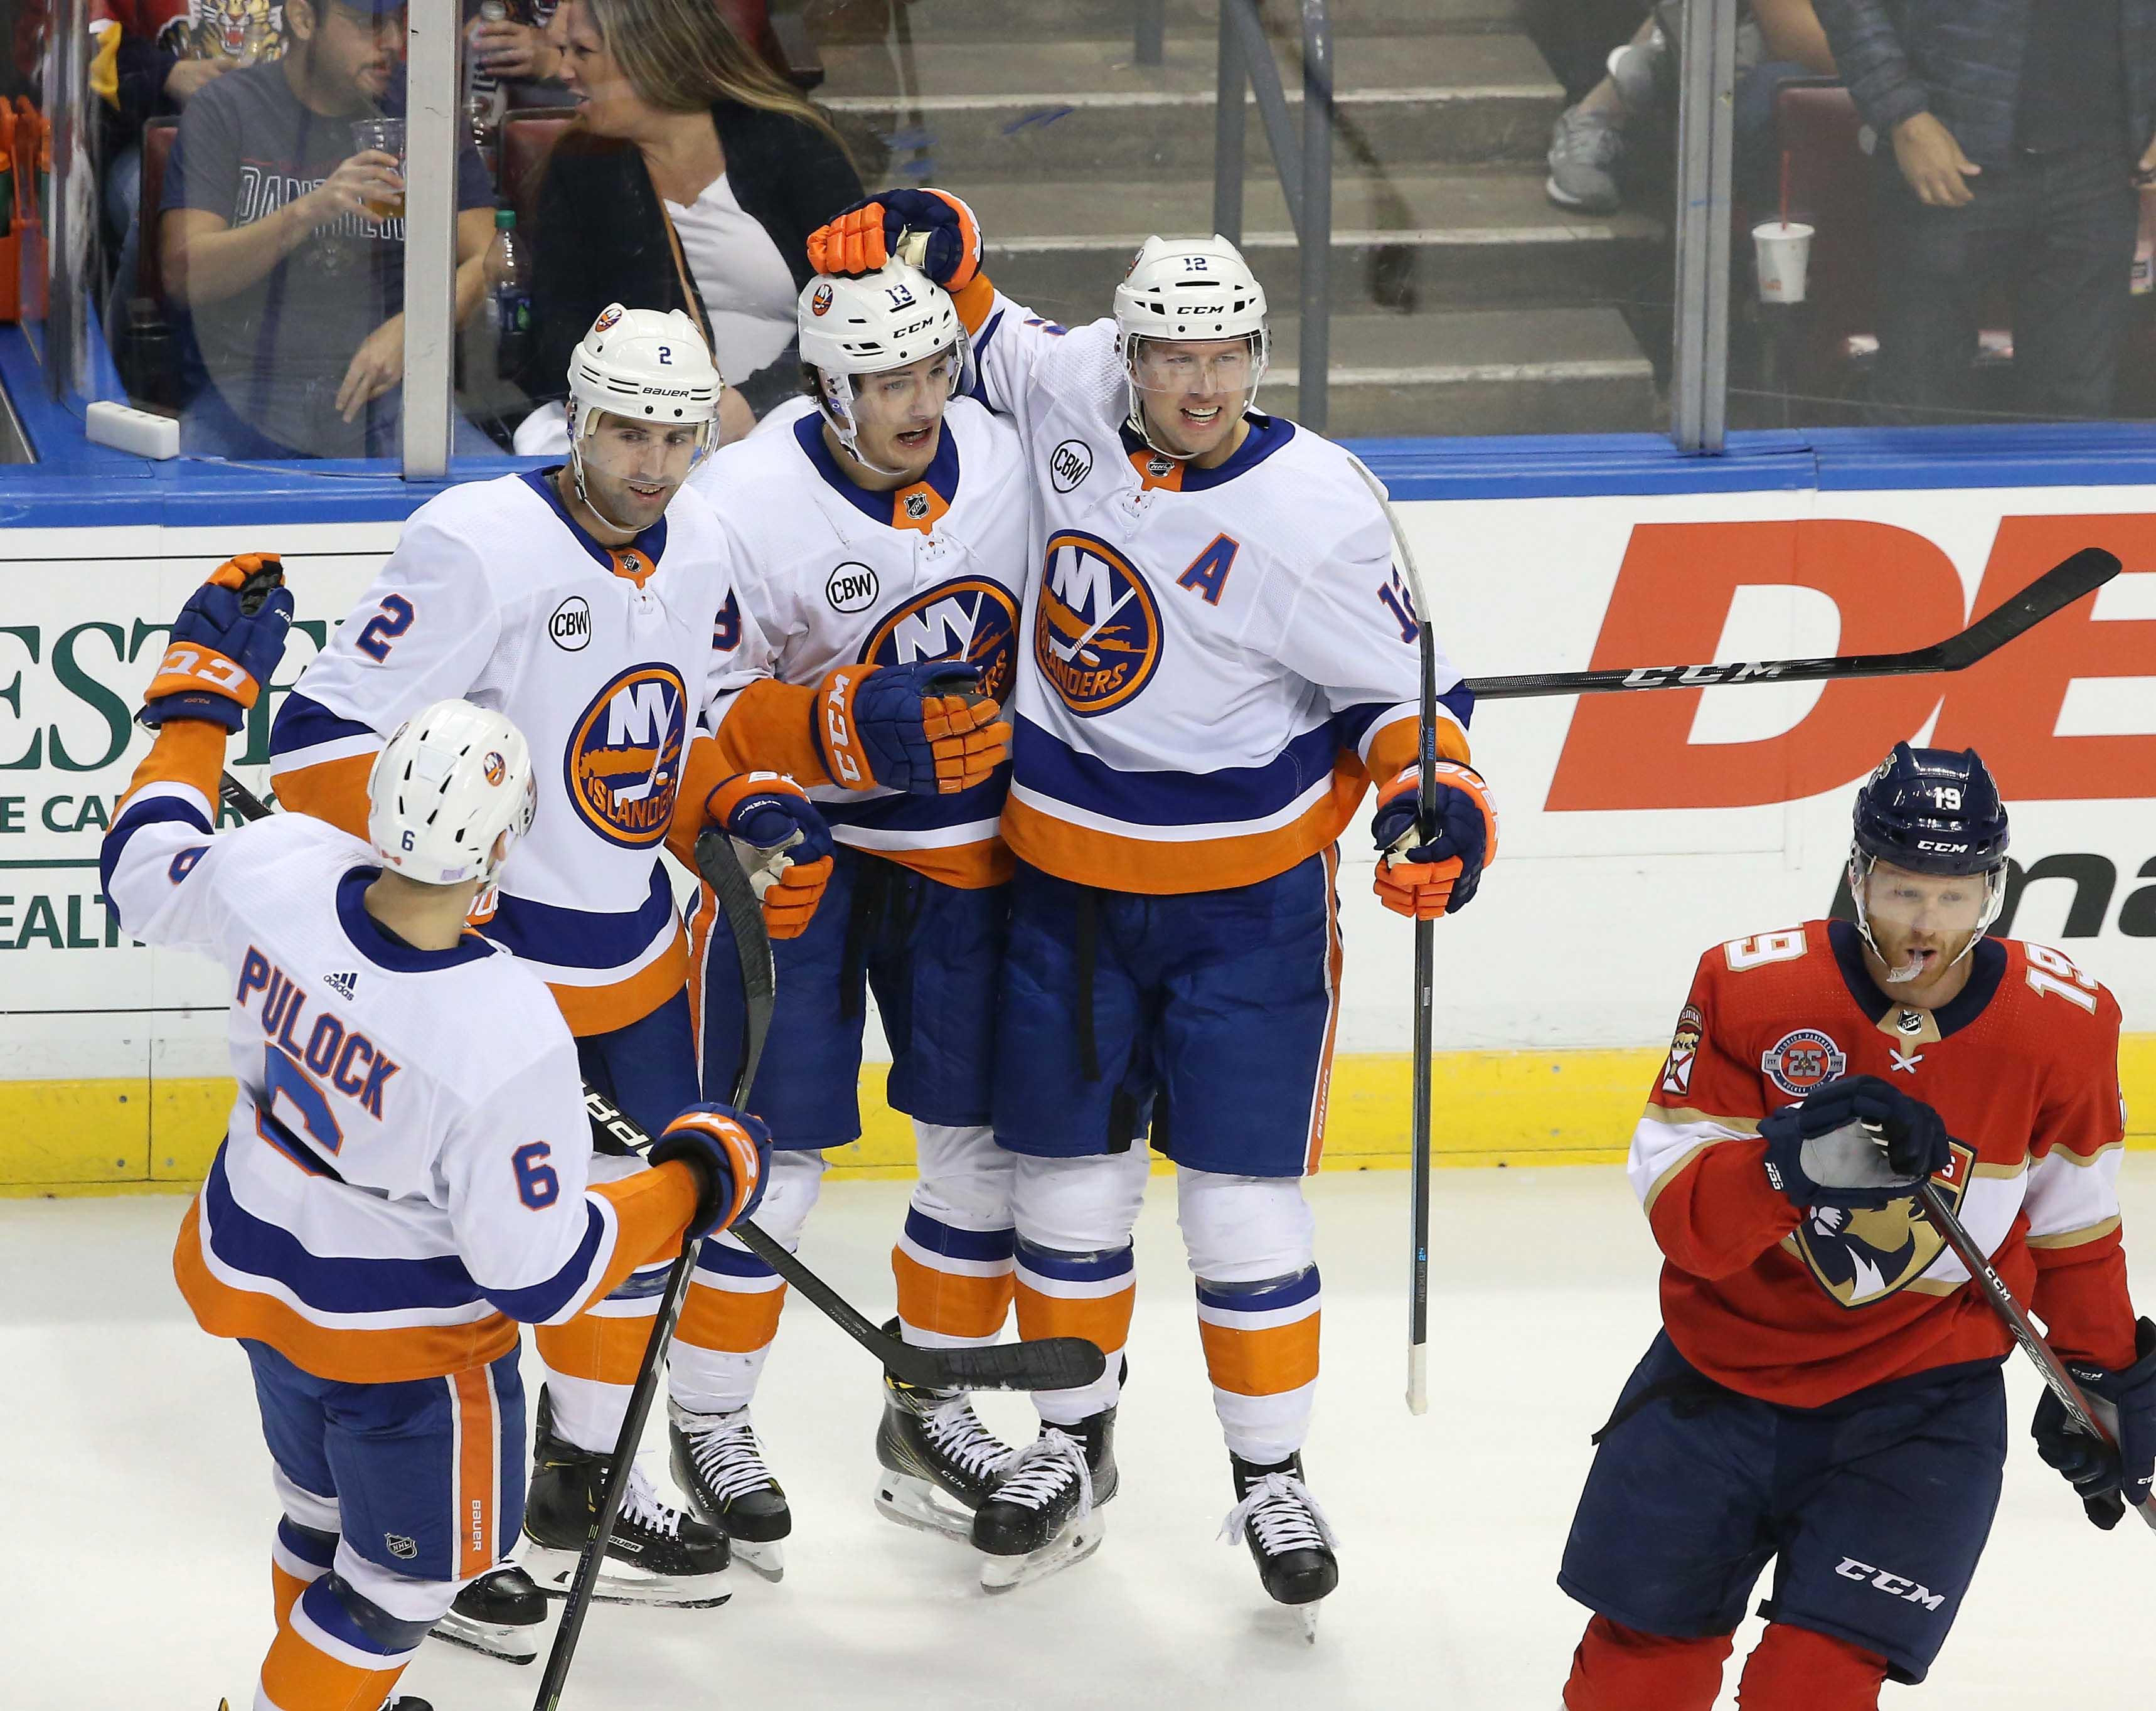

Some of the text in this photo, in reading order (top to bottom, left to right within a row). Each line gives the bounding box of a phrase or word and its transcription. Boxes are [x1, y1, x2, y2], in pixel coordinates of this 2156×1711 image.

[1184, 257, 1208, 271] 12
[885, 284, 913, 306] 13
[1177, 306, 1225, 314] CCM
[893, 316, 934, 339] CCM
[658, 346, 672, 365] 2
[642, 387, 689, 397] BAUER
[1054, 447, 1089, 485] CBW
[1176, 531, 1240, 607] A
[831, 573, 872, 604] CBW
[1050, 545, 1136, 625] NY
[355, 593, 415, 663] 2
[554, 610, 588, 637] CBW
[894, 591, 984, 665] NY
[1622, 661, 1783, 688] CCM
[607, 682, 678, 745] NY
[826, 673, 860, 782] CCM
[1426, 727, 1434, 760] BAUER
[1934, 786, 1961, 811] 19
[401, 829, 415, 852] 6
[1917, 840, 1968, 853] CCM
[323, 974, 355, 1001] adidas
[237, 944, 402, 1122] PULOCK
[1777, 1033, 1833, 1054] FLORIDA PANTHERS
[1788, 1050, 1822, 1077] 25
[1783, 1080, 1806, 1093] HOCKEY
[511, 1140, 560, 1212] 6
[1764, 1162, 1781, 1190] CCM
[1985, 1265, 2012, 1301] CCM
[2072, 1368, 2103, 1379] CCM
[942, 1470, 966, 1488] CCM
[472, 1500, 483, 1552] BAUER
[392, 1541, 410, 1552] NHL
[609, 1536, 639, 1552] AUER
[1835, 1556, 1945, 1611] CCM
